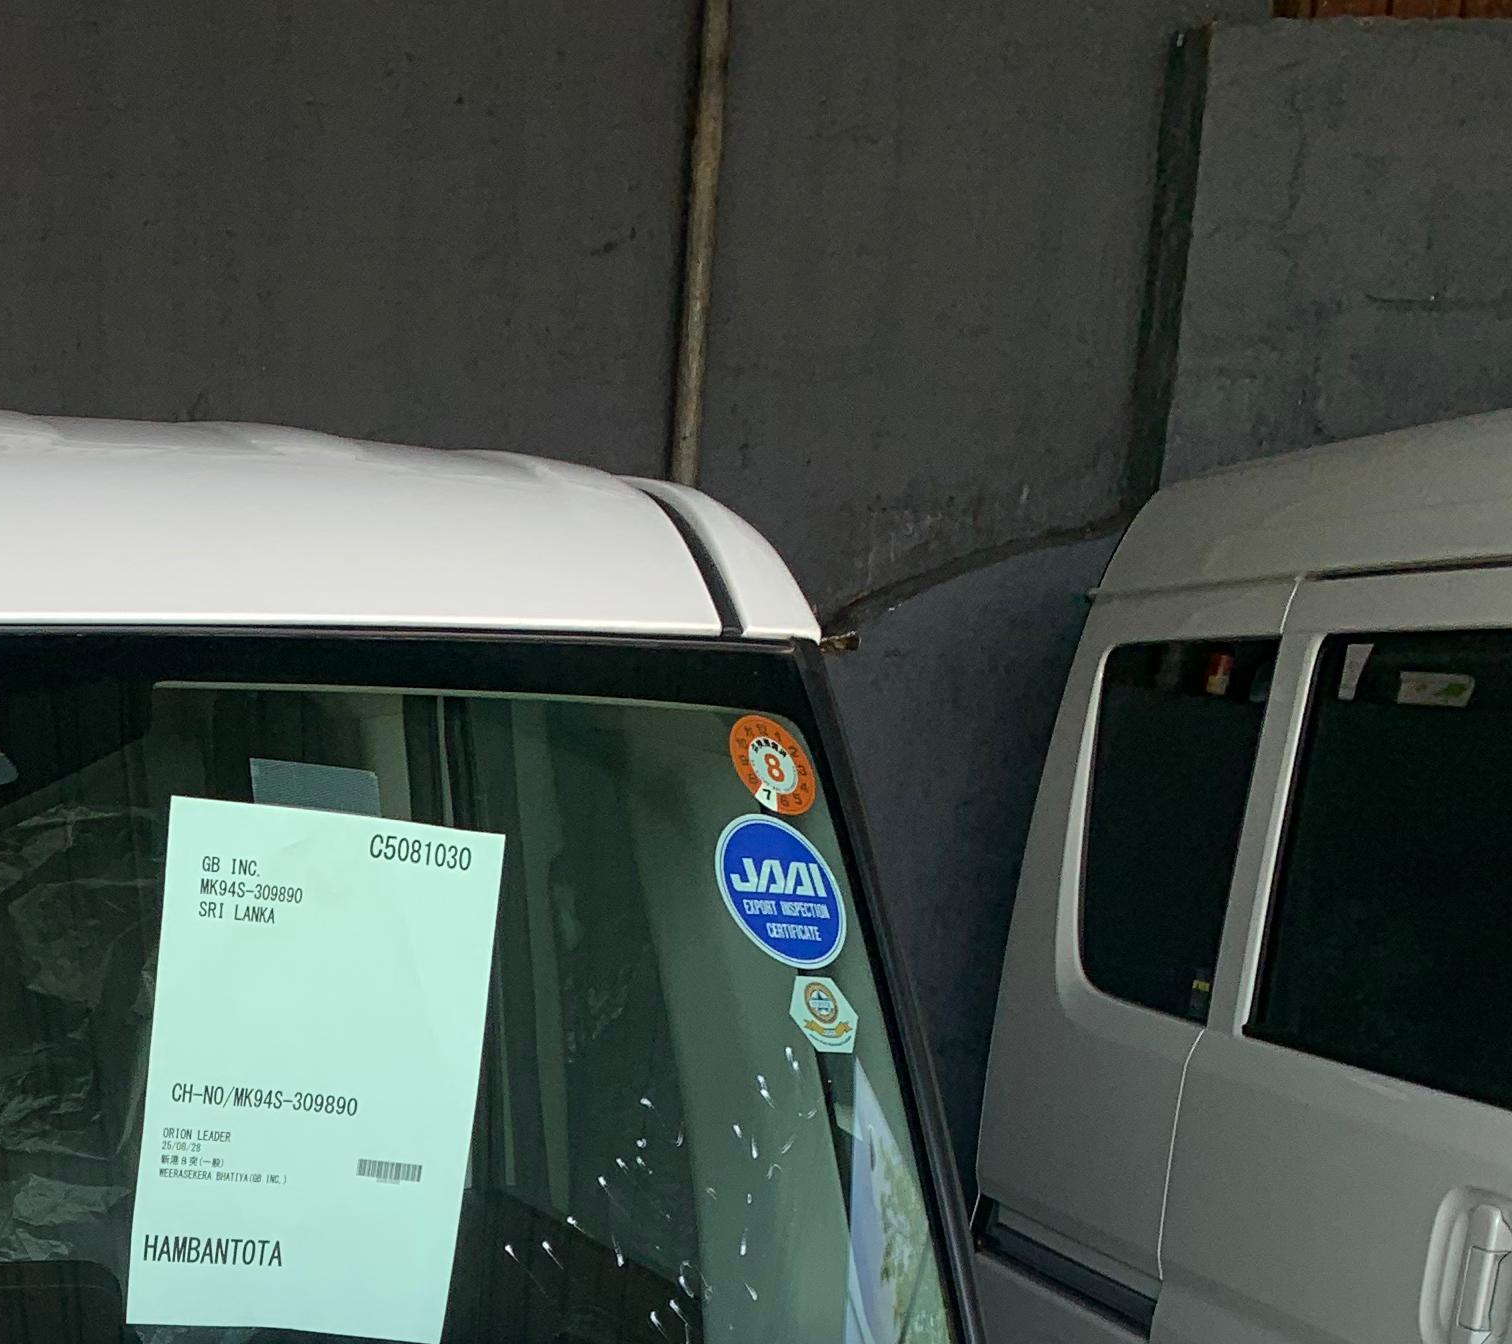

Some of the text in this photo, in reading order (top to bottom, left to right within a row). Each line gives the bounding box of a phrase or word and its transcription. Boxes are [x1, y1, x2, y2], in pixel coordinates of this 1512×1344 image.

[764, 752, 785, 782] 8
[762, 788, 772, 801] 7
[369, 834, 472, 871] C5081030
[201, 856, 261, 877] GB INC.
[729, 857, 828, 898] JAAI
[199, 878, 303, 904] MK94S-309890
[198, 901, 276, 925] SRI LANKA
[742, 899, 831, 920] EXPORT INSPECTION
[765, 921, 823, 942] CERTIFICATE
[171, 1082, 358, 1117] CH-NO/MK94S-309890
[163, 1127, 231, 1143] ORION LEADER
[159, 1168, 212, 1181] WEERASEKERA
[143, 1233, 283, 1268] HAMBANTOTA
